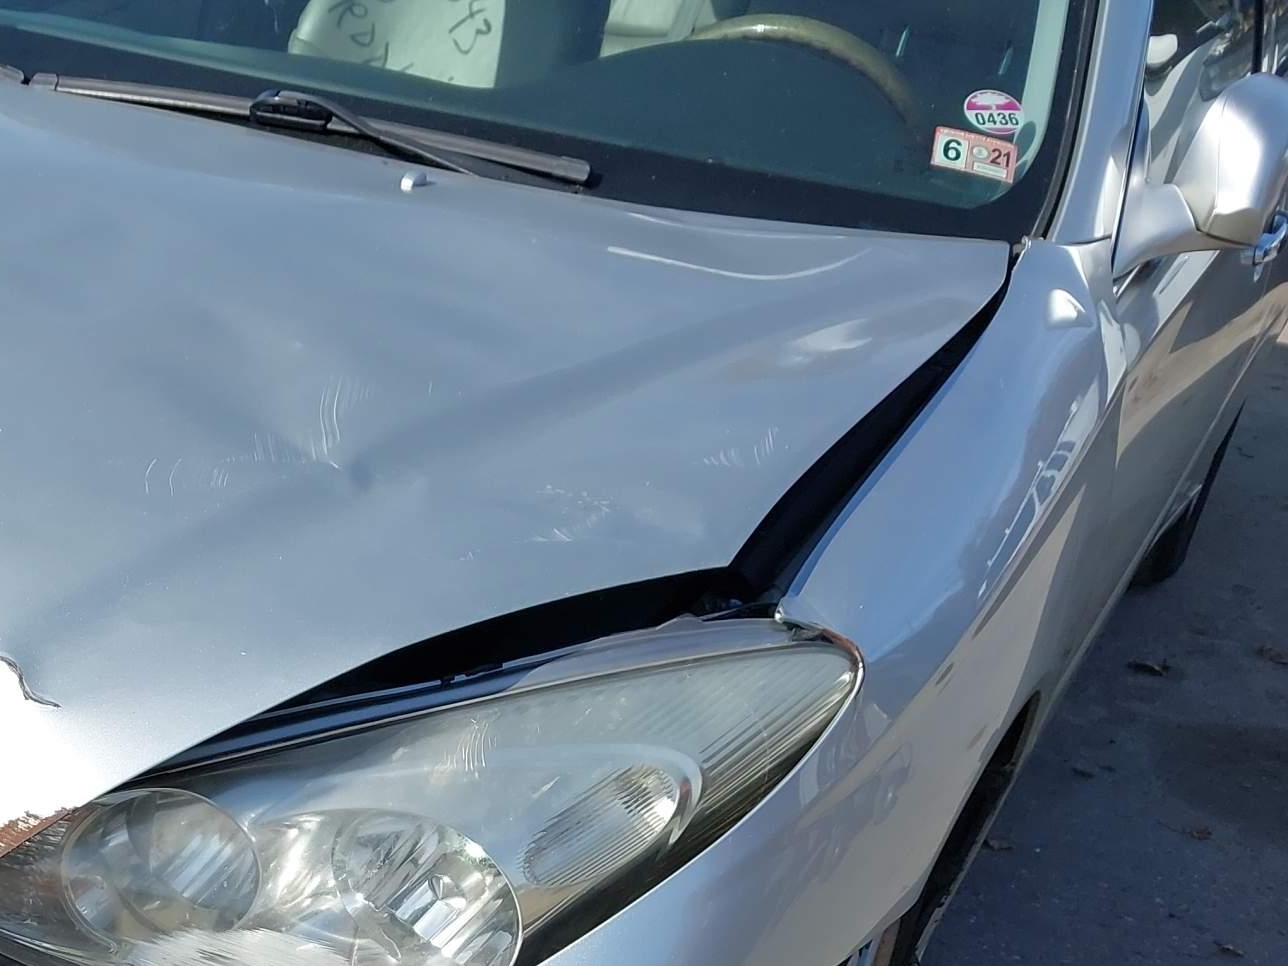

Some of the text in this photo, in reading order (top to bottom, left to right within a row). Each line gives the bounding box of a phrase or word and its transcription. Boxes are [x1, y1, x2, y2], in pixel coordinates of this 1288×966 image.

[974, 111, 1020, 126] 0436
[942, 138, 1011, 168] 6 21
